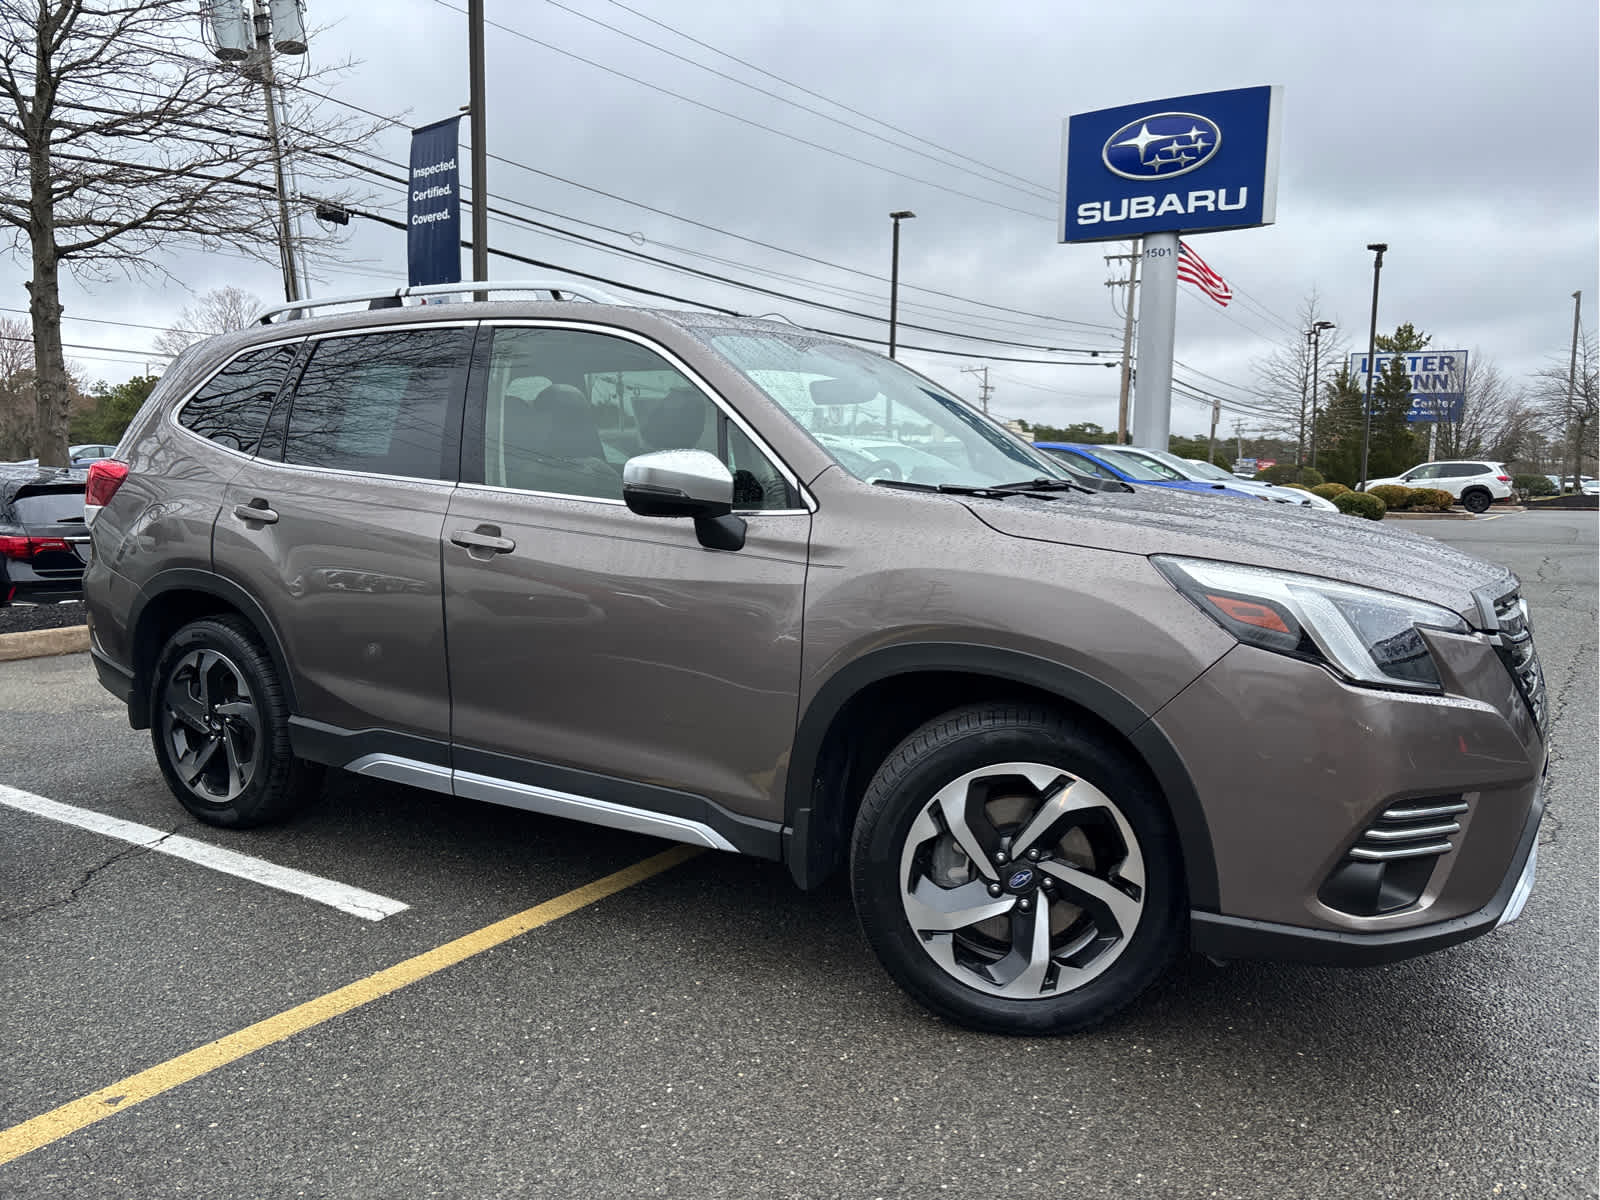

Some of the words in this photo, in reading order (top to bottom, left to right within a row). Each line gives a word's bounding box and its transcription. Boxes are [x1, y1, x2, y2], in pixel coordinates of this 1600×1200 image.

[413, 158, 457, 178] Inspected.
[412, 184, 453, 202] Certified.
[1077, 186, 1248, 225] SUBARU
[411, 208, 451, 225] Covered.
[1145, 247, 1172, 258] 1501
[1361, 355, 1456, 373] LETER
